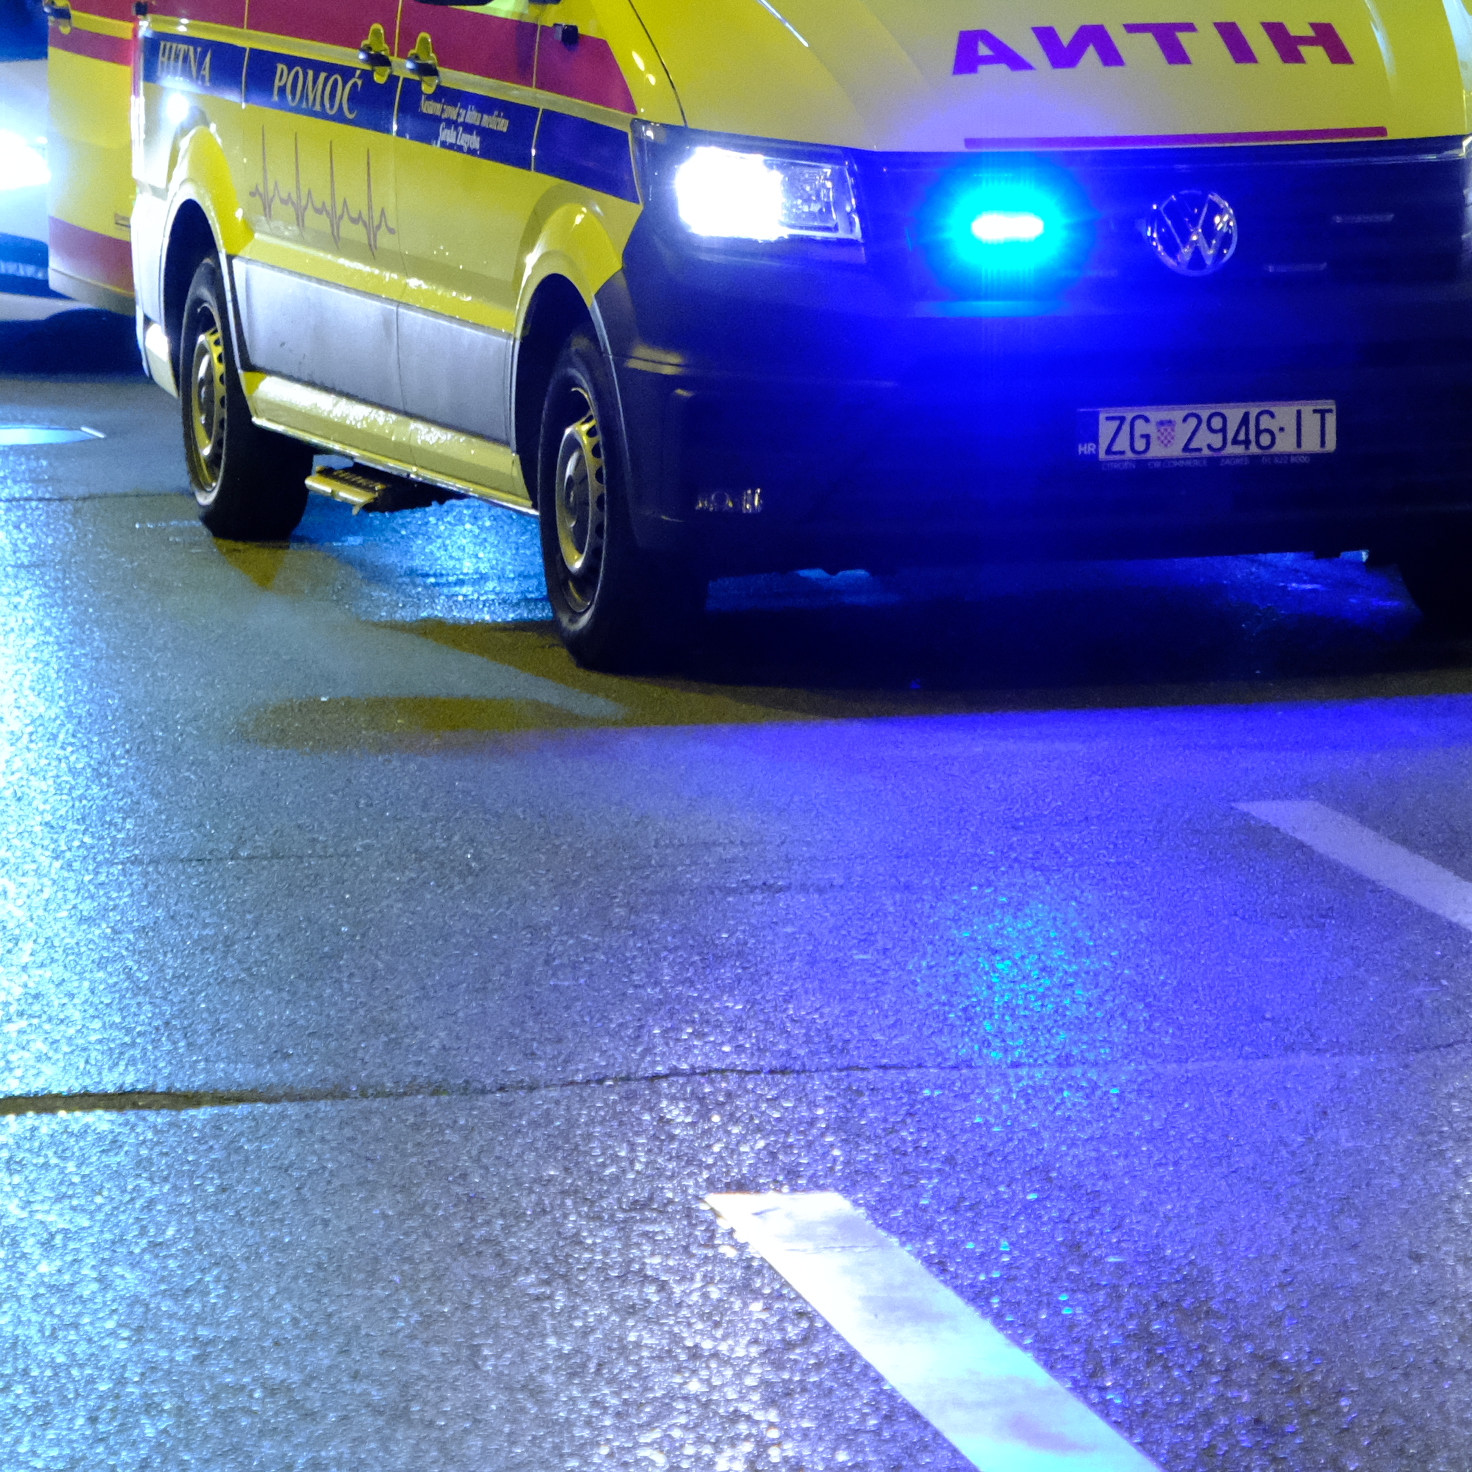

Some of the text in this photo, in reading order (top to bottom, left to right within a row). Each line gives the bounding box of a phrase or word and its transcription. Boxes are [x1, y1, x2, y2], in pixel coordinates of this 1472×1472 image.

[157, 40, 363, 120] HITNA POMOĆ
[1079, 443, 1097, 456] HR
[1104, 414, 1152, 456] ZG
